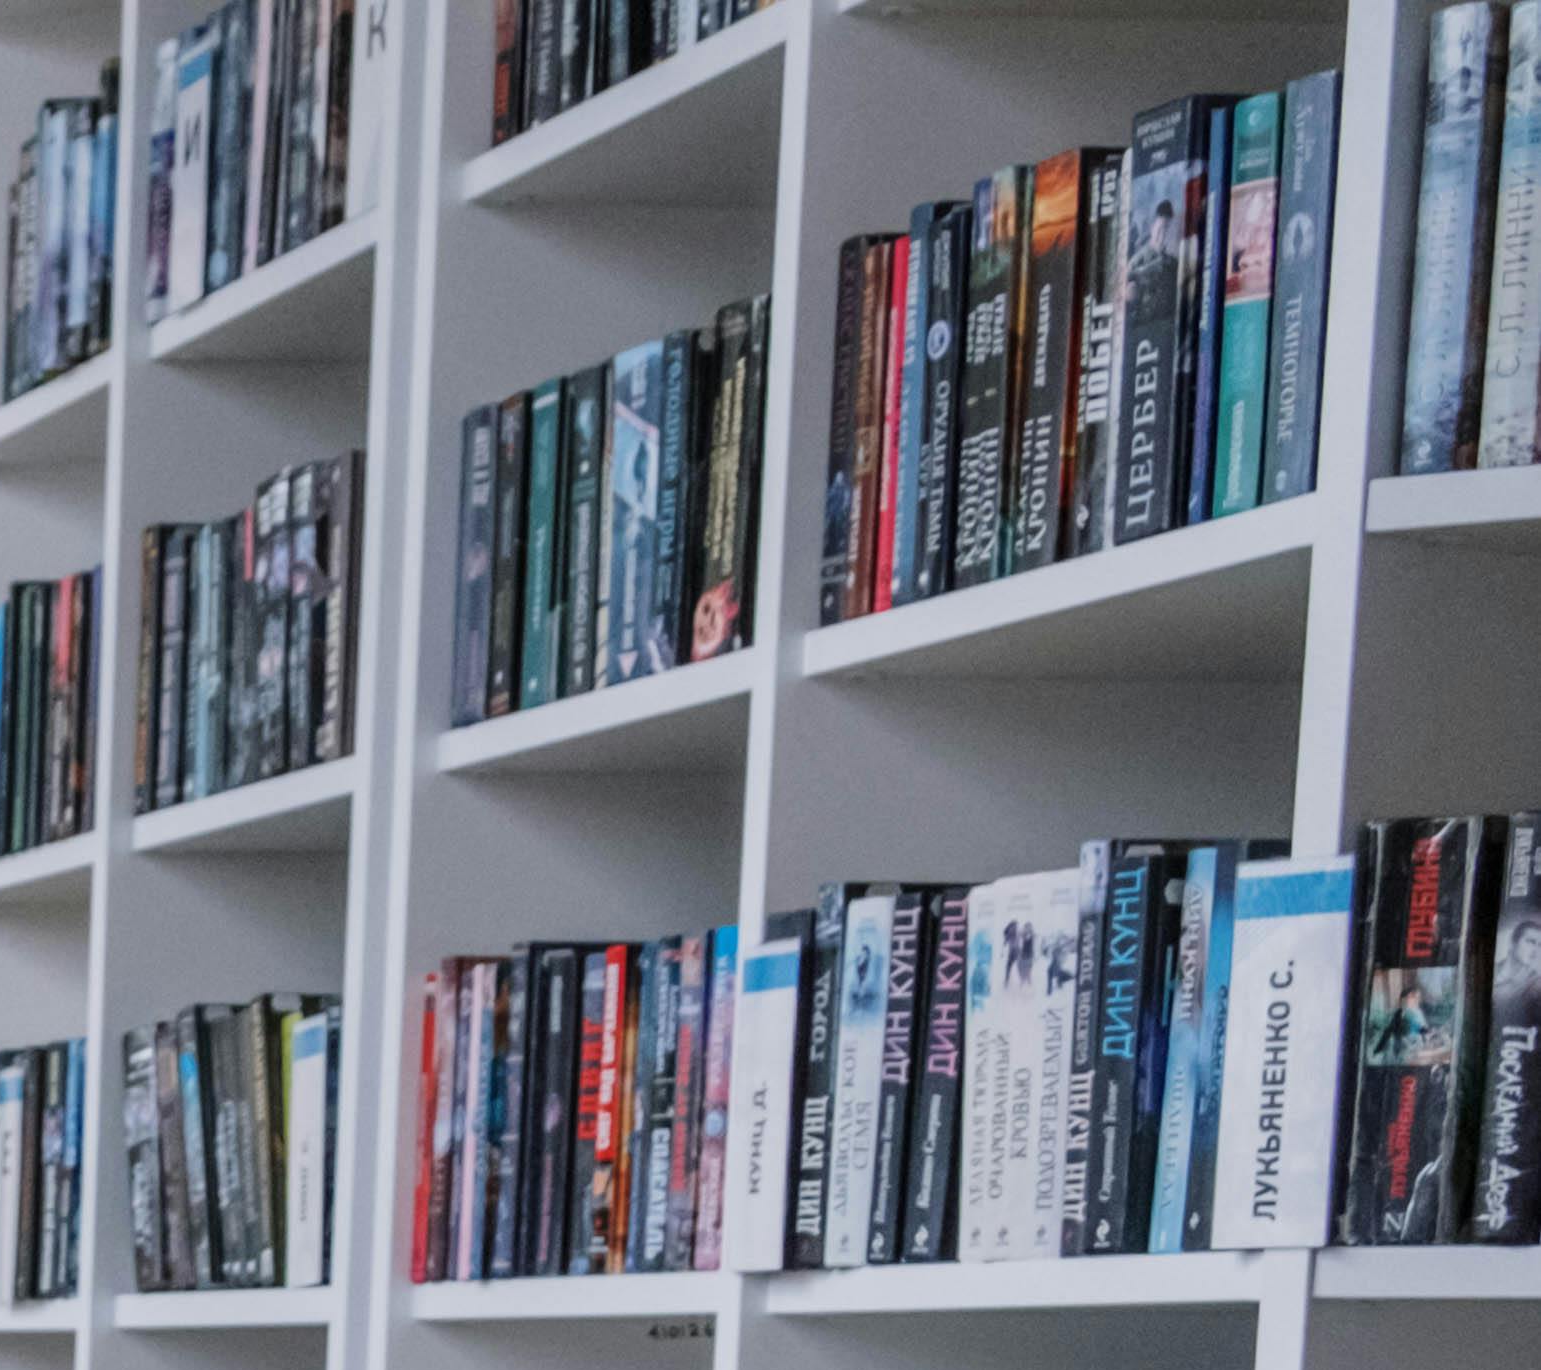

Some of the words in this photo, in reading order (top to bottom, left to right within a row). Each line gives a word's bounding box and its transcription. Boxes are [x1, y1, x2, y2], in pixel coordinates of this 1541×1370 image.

[1500, 162, 1536, 290] ЛИННИ
[1033, 284, 1051, 388] ДВЕНАДЦАТЬ
[1084, 301, 1115, 423] ПОБЕГ
[1495, 347, 1521, 379] С.
[1498, 301, 1526, 334] Л.
[1276, 292, 1305, 444] ТЕМНОГОРЬЕ
[1125, 340, 1161, 527] ЦЕРБЕР
[960, 434, 982, 568] КРОНИН
[978, 426, 1000, 561] КРОНИН
[1028, 414, 1053, 552] КРОНИН
[1107, 865, 1147, 965] КУНЦ
[1405, 837, 1441, 959] ГЛУБИНА
[888, 907, 922, 1000] КУНЦ
[934, 900, 967, 991] КУНЦ
[1269, 959, 1295, 990] С.
[808, 970, 831, 1063] ГОРОД
[882, 1012, 911, 1085] ДИН
[928, 1003, 958, 1077] ДИН
[1101, 978, 1137, 1061] ДИН
[753, 1081, 769, 1111] Д.
[800, 1095, 829, 1170] КУНЦ
[854, 1101, 874, 1171] СЕМЯ
[988, 1032, 1011, 1201] ОЧАРОВАННЫЙ
[1010, 1068, 1031, 1160] КРОВЬЮ
[1034, 1006, 1064, 1212] ПОДОЗРЕВАЕМЫЙ
[1065, 1069, 1096, 1150] КУНЦ
[1251, 1001, 1291, 1222] ЛУКЬЯНЕНКО
[1389, 1075, 1417, 1199] ЛУКЬЯНЕНКО
[645, 1127, 671, 1259] СПАСАТЕЛЬ
[748, 1119, 769, 1196] КУНЦ
[1062, 1161, 1086, 1223] ДИН
[795, 1180, 822, 1237] ДИН
